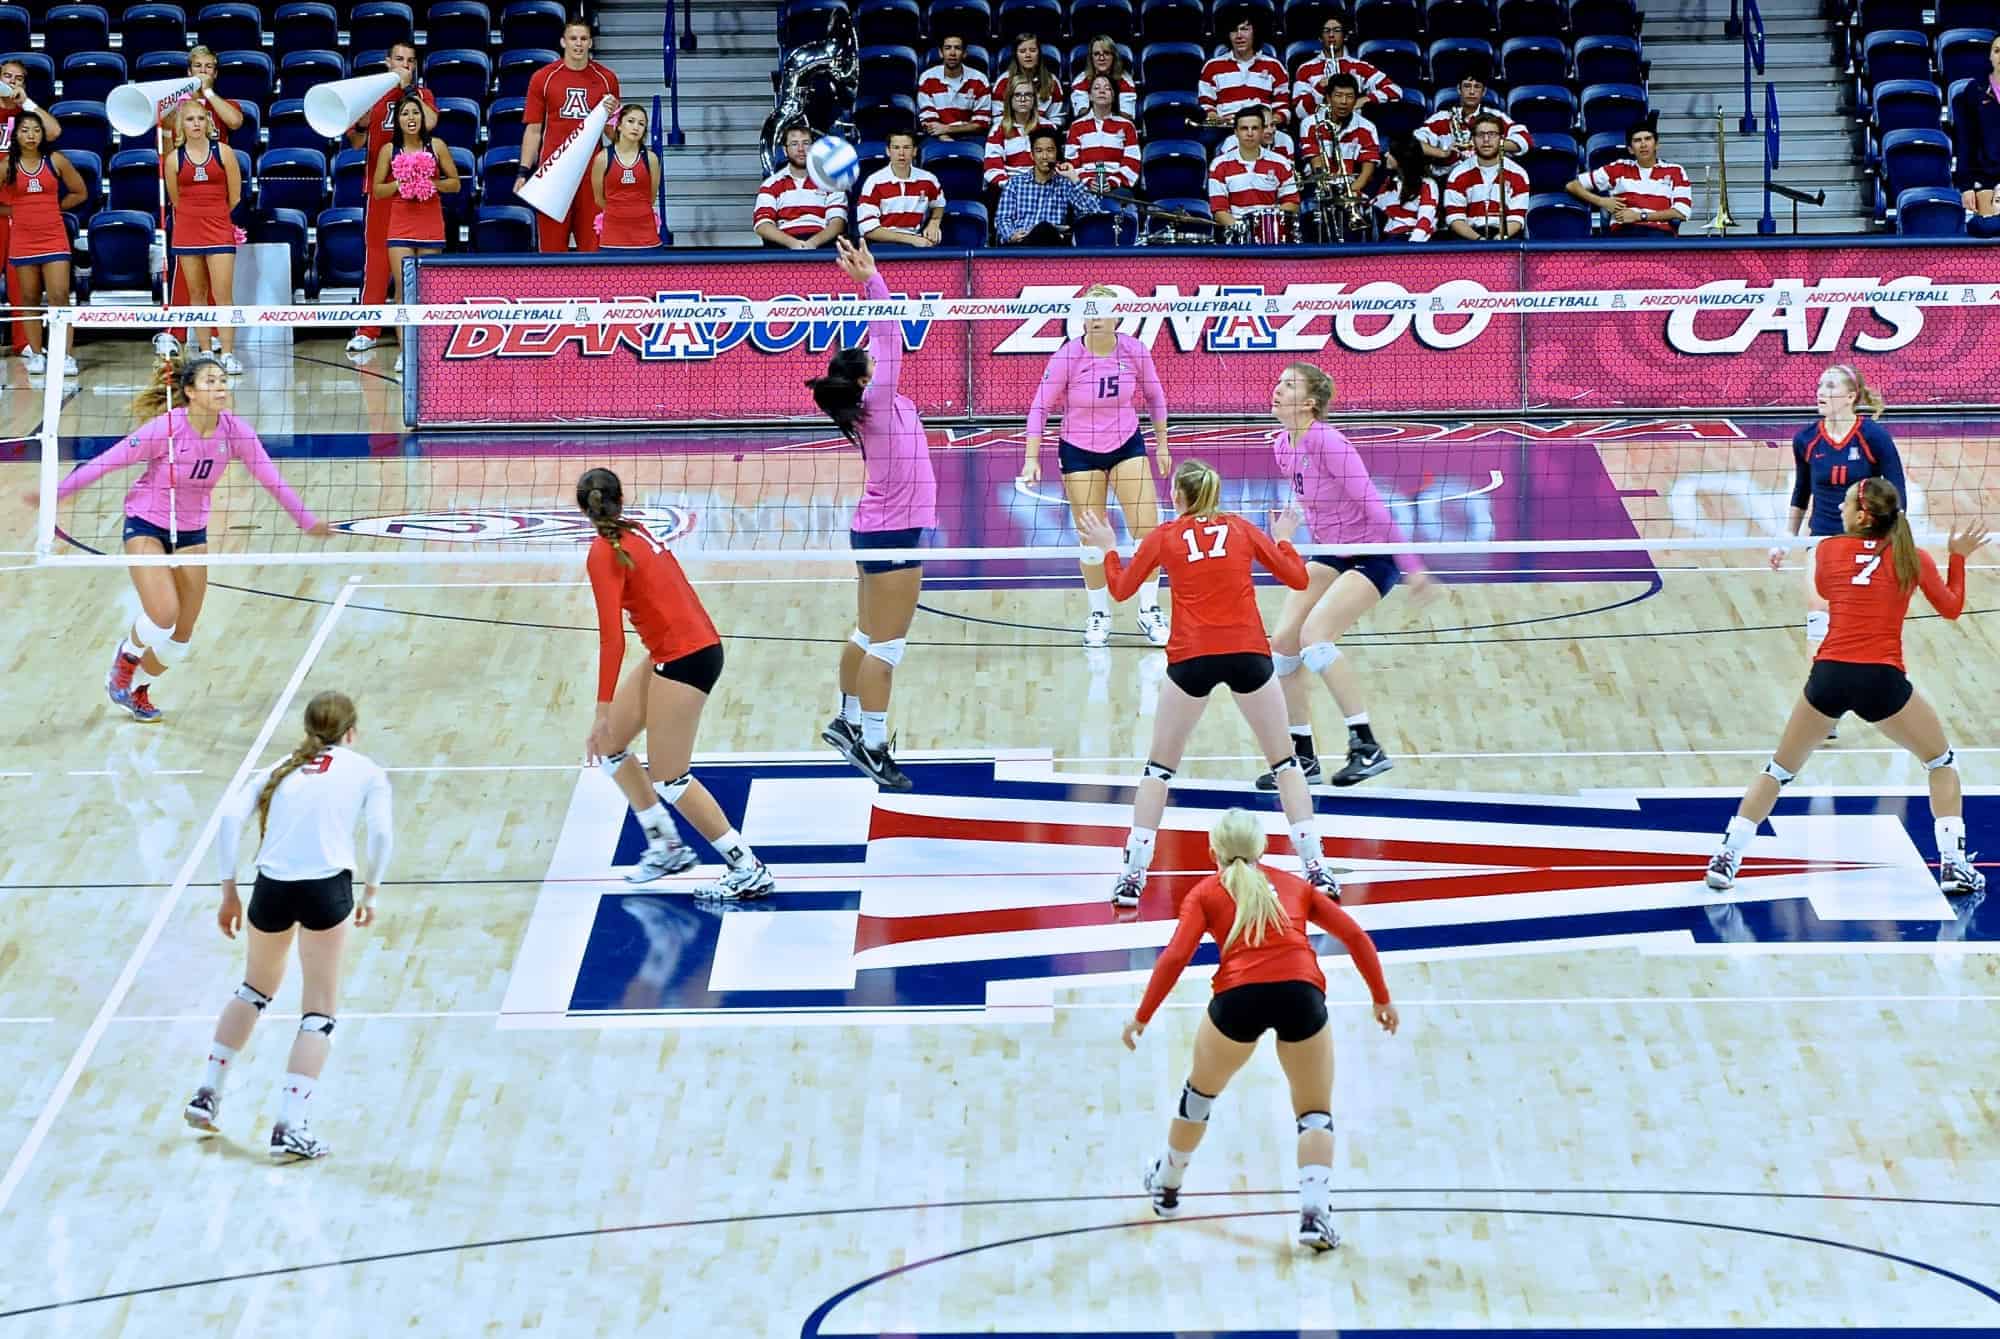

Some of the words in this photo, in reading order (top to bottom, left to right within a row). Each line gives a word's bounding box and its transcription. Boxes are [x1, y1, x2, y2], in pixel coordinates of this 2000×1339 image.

[559, 88, 592, 119] A
[535, 122, 585, 178] ARIZONA
[78, 310, 218, 323] ARIZONAVOLLEYBALL
[258, 310, 382, 322] ARIZONAWILDCATS
[422, 308, 563, 321] ARIZONAVOLLEYBALL
[603, 307, 727, 320] ARIZONAWILDCATS
[767, 304, 907, 317] ARIZONAVOLLEYBALL
[947, 303, 1071, 315] ARIZONAWILDCATS
[1111, 301, 1252, 314] ARIZONAVOLLEYBALL
[1292, 299, 1416, 311] ARIZONAWILDCATS
[1457, 296, 1599, 309] ARIZONAVOLLEYBALL
[1640, 294, 1764, 306] ARIZONAWILDCATS
[1807, 290, 1949, 304] ARIZONAVOLLEYBALL
[1667, 276, 1933, 353] CATS
[1098, 375, 1120, 399] 15
[766, 417, 1748, 451] ARZONA
[189, 459, 214, 480] 10
[1831, 465, 1848, 485] 11
[1181, 523, 1230, 563] 17
[1850, 553, 1881, 586] 7
